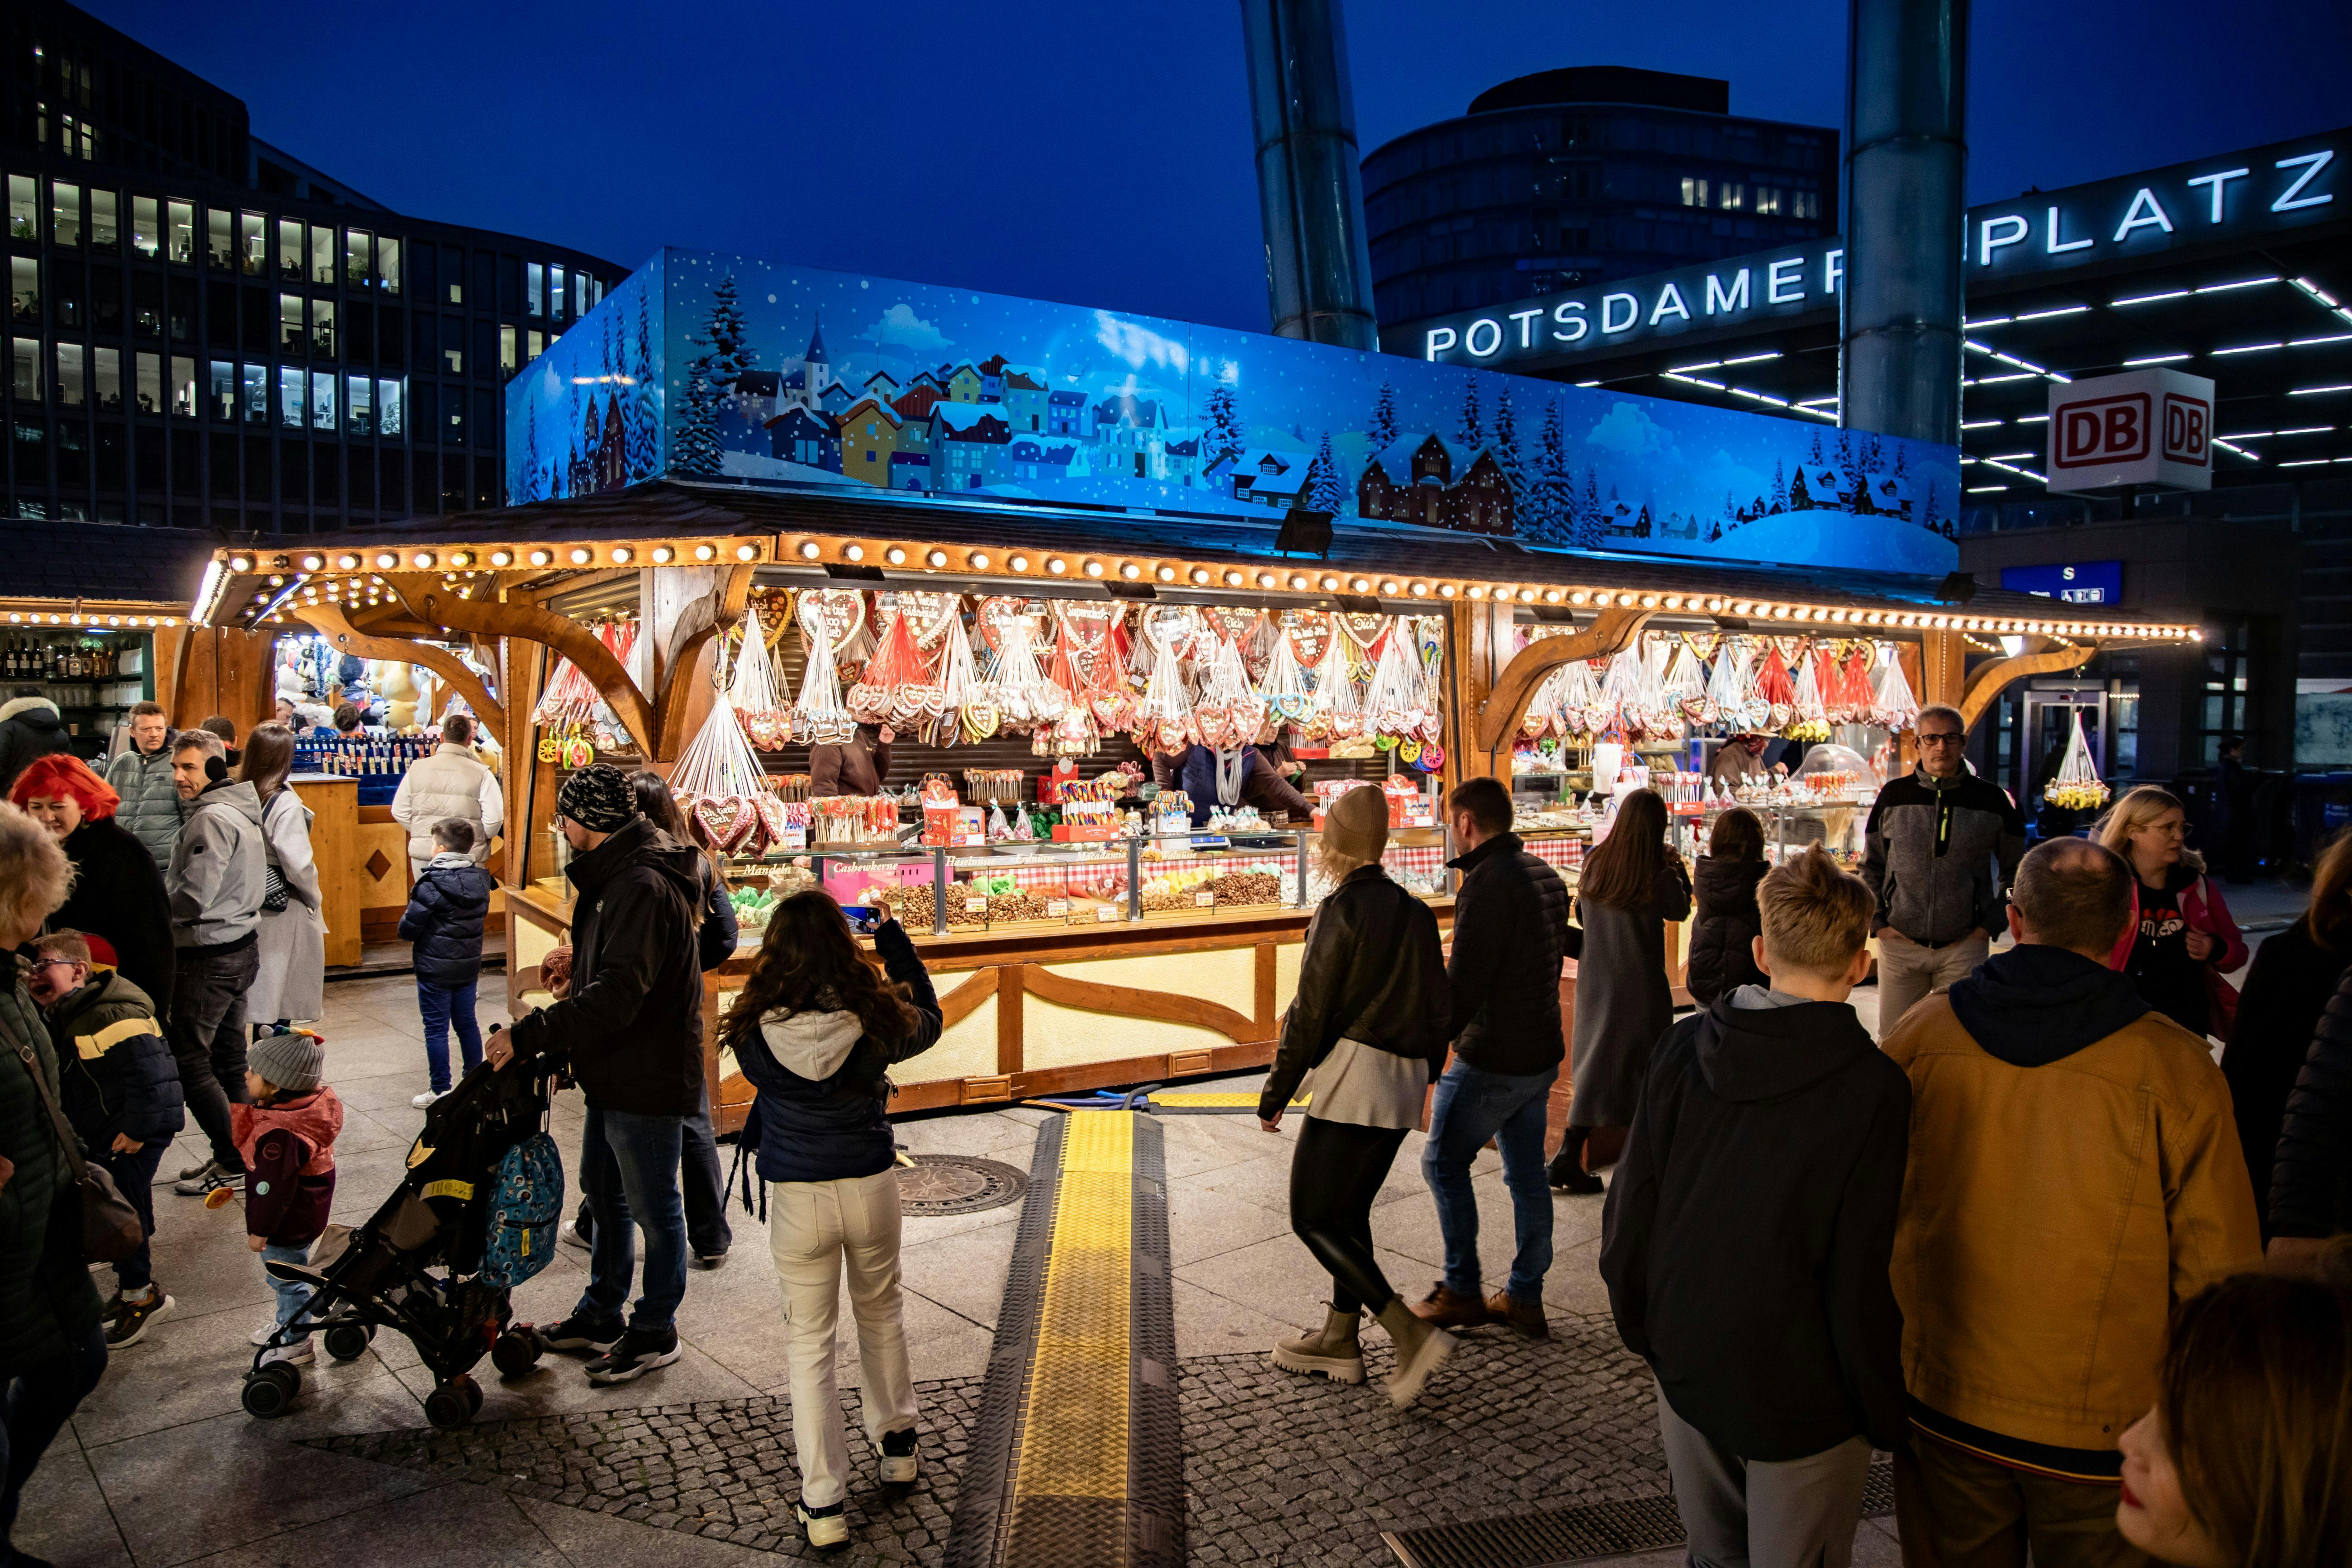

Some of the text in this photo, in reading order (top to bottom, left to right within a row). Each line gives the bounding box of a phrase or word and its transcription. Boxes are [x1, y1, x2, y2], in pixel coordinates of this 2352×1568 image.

[1980, 150, 2334, 266] PLATZ
[2067, 406, 2139, 457] DB
[2169, 404, 2203, 454] DB
[2063, 567, 2075, 580] S
[1067, 602, 1110, 621] Superschat
[1224, 616, 1244, 629] Dich
[1354, 618, 1377, 631] Dich
[699, 805, 739, 819] Ich liebe
[708, 815, 732, 826] Dich
[945, 856, 996, 867] Haselnüsse
[1015, 853, 1055, 864] Erdnüsse
[1076, 851, 1127, 862] Macadamia
[1161, 851, 1198, 860] Walnüsse
[743, 863, 792, 875] Mandeln
[834, 861, 898, 873] Cashewkerne
